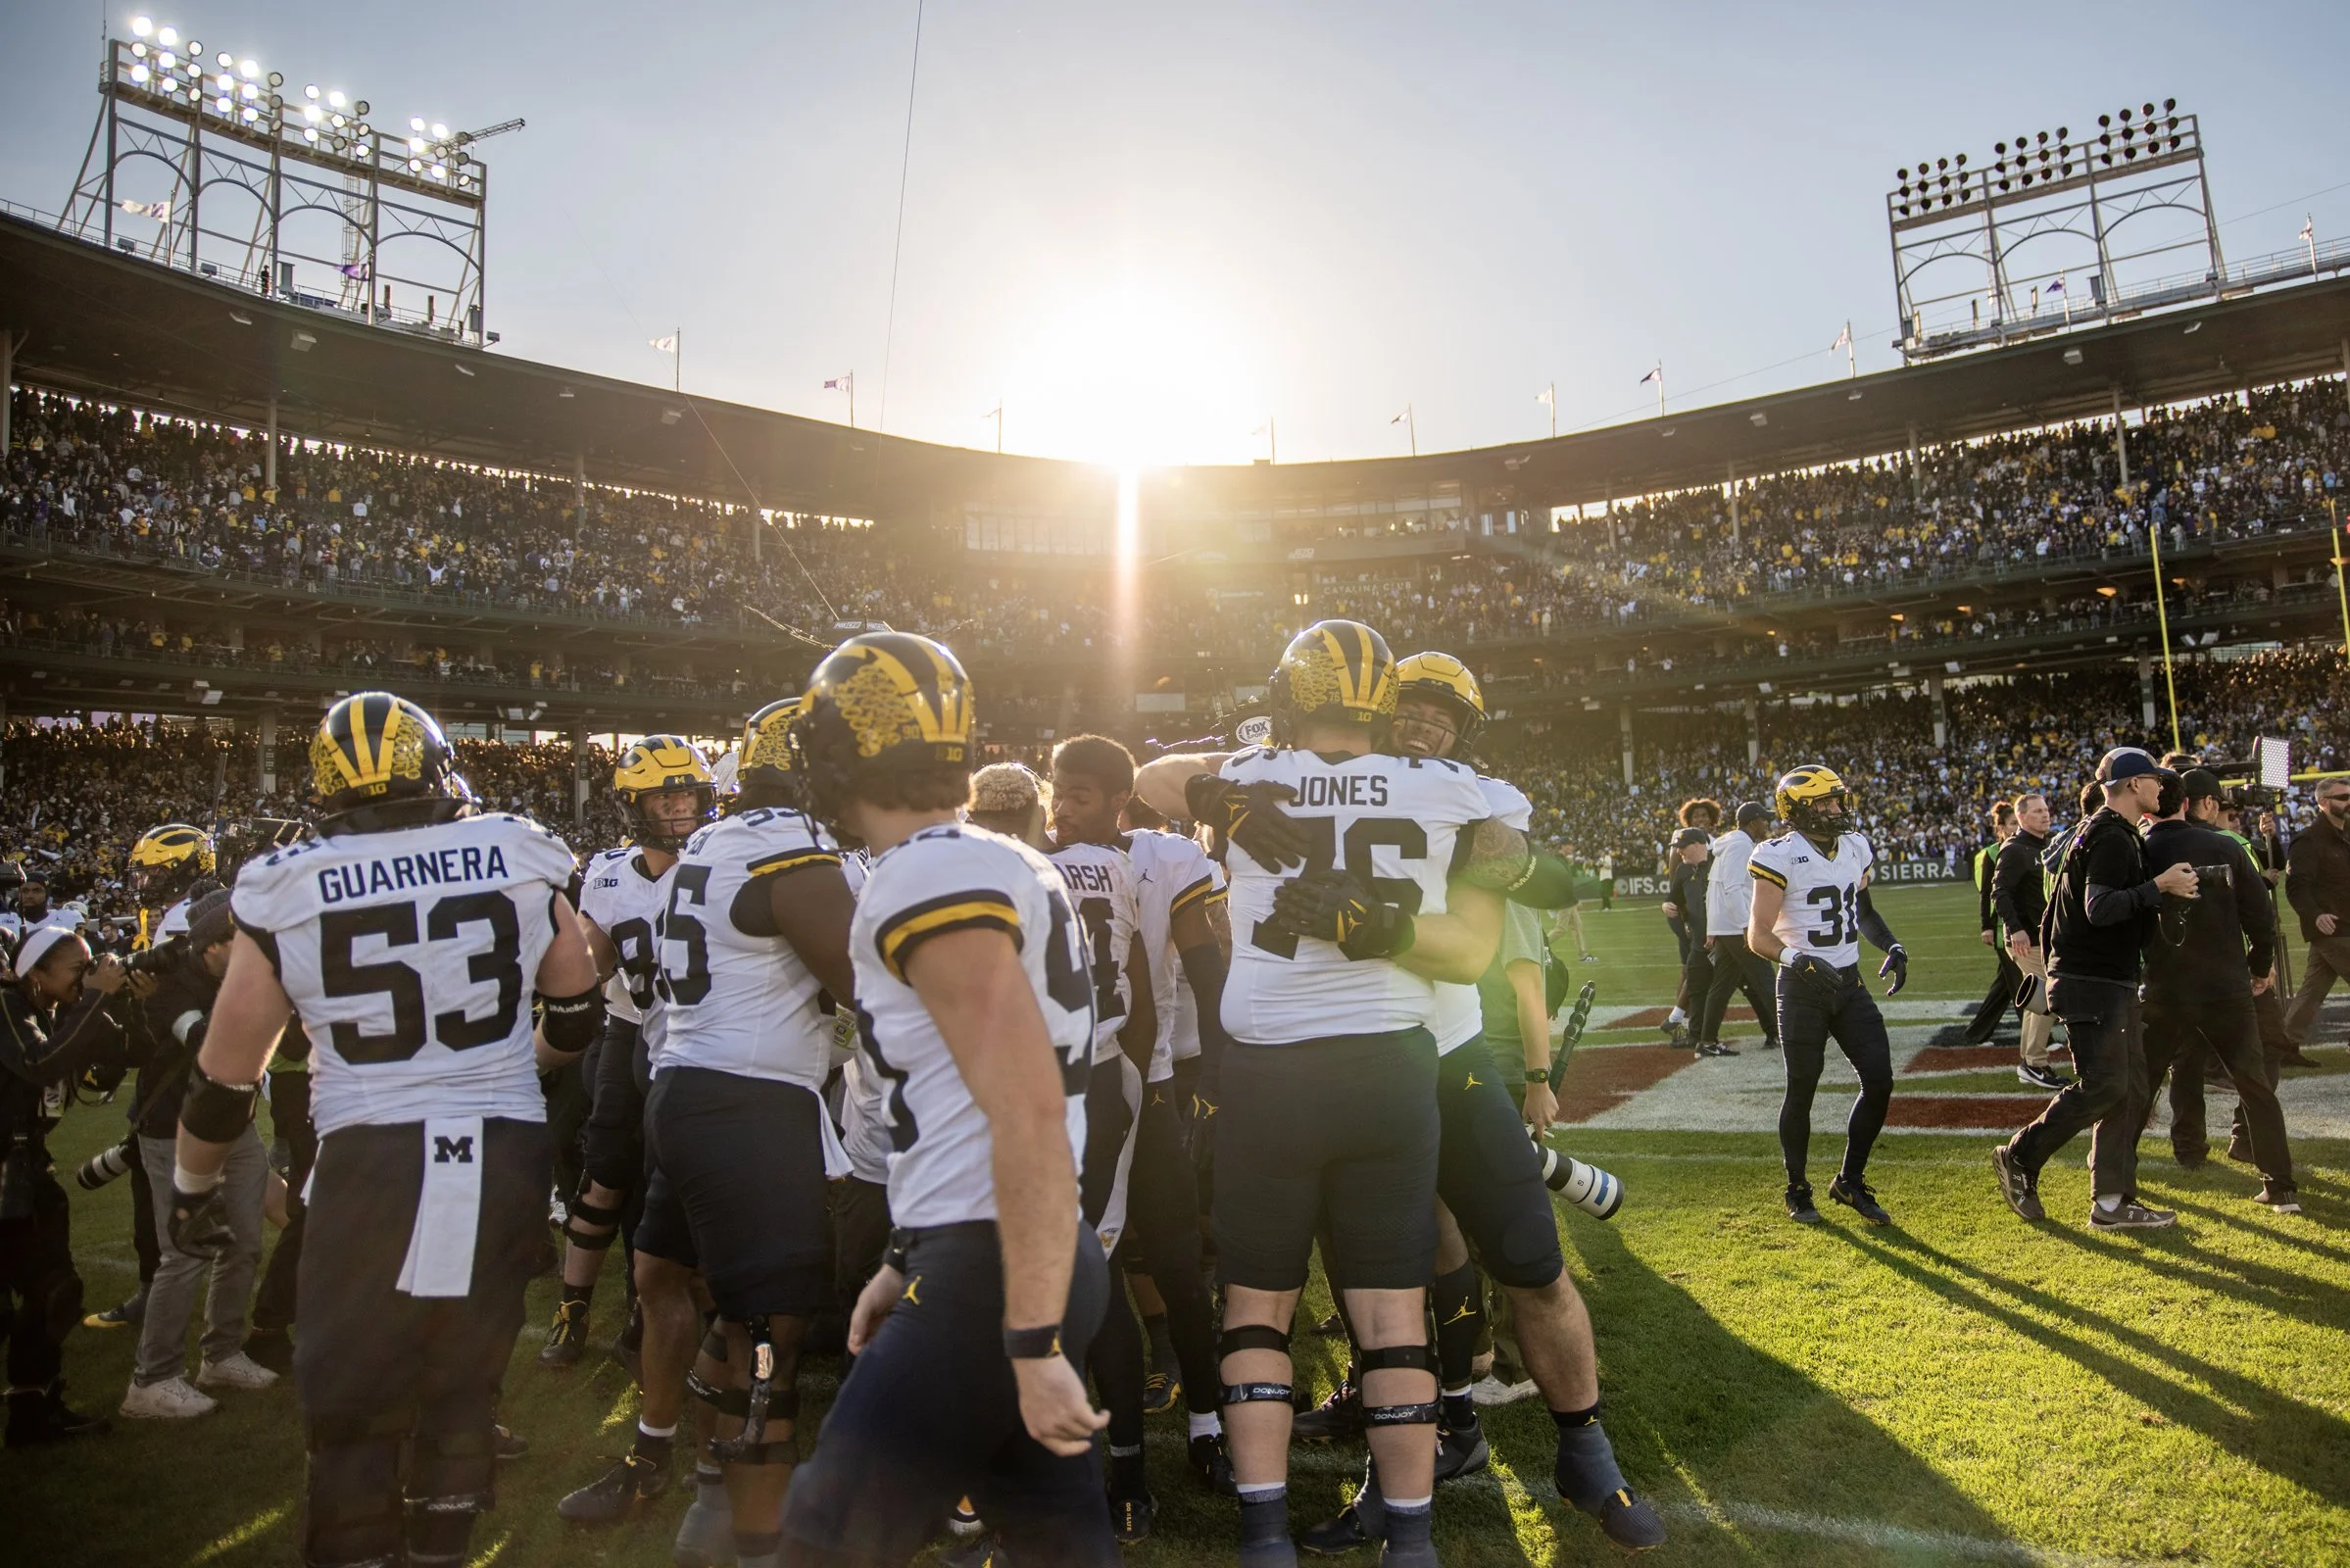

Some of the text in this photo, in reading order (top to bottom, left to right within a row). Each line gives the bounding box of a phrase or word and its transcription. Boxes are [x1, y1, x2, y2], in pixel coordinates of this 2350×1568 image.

[1324, 581, 1412, 595] CATALINA CLUB
[1245, 721, 1268, 735] FOX
[1289, 775, 1389, 807] JONES
[318, 846, 509, 904] GUARNERA
[1881, 862, 1955, 880] SIERRA
[1807, 882, 1858, 948] 31
[319, 890, 522, 1065] 53
[434, 1136, 473, 1163] M
[1252, 1387, 1292, 1396] DONJOY
[1374, 1410, 1414, 1420] DONJOY
[427, 1500, 475, 1510] DONJOY
